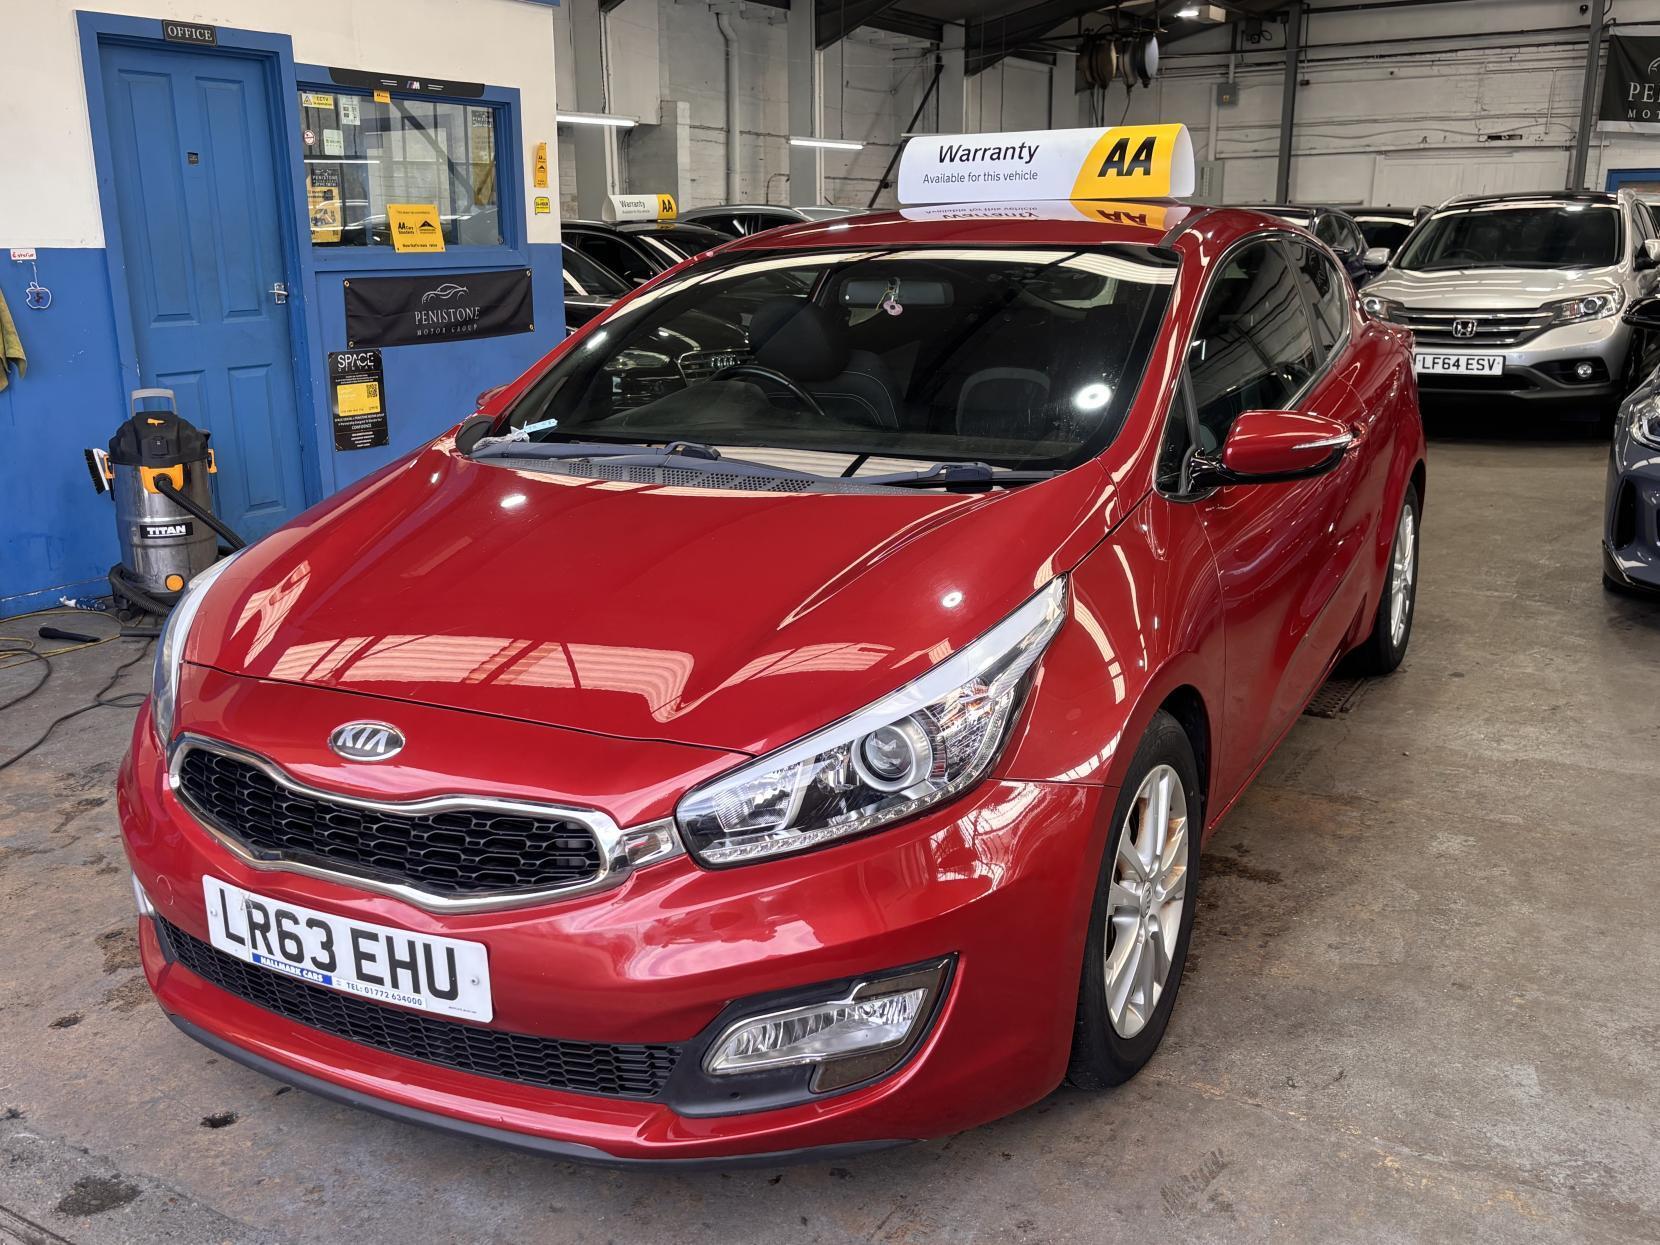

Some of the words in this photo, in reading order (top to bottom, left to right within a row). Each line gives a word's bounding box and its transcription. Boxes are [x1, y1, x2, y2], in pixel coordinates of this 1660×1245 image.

[168, 25, 213, 41] OFFICE
[1628, 81, 1660, 103] PE
[939, 141, 1040, 164] Warranty
[1097, 136, 1157, 177] AA
[922, 170, 966, 184] Available
[968, 171, 982, 183] for
[983, 171, 1001, 182] this
[1003, 170, 1038, 181] vehicle
[619, 199, 646, 209] Warranty
[662, 199, 674, 213] AA
[414, 307, 481, 325] PENISTONE
[417, 327, 446, 336] MOTOR
[451, 324, 478, 333] GROUP
[337, 352, 375, 369] SPACE
[1421, 356, 1461, 371] LF64
[1465, 358, 1497, 373] ESV
[146, 525, 186, 537] TITAN
[336, 726, 390, 753] KIA
[218, 887, 338, 974] LR63
[349, 926, 459, 1002] EHU
[260, 956, 302, 976] HALLMARK
[302, 969, 324, 982] CARS
[346, 982, 363, 993] TEL:
[364, 986, 390, 999] 01772
[391, 993, 423, 1006] 634000
